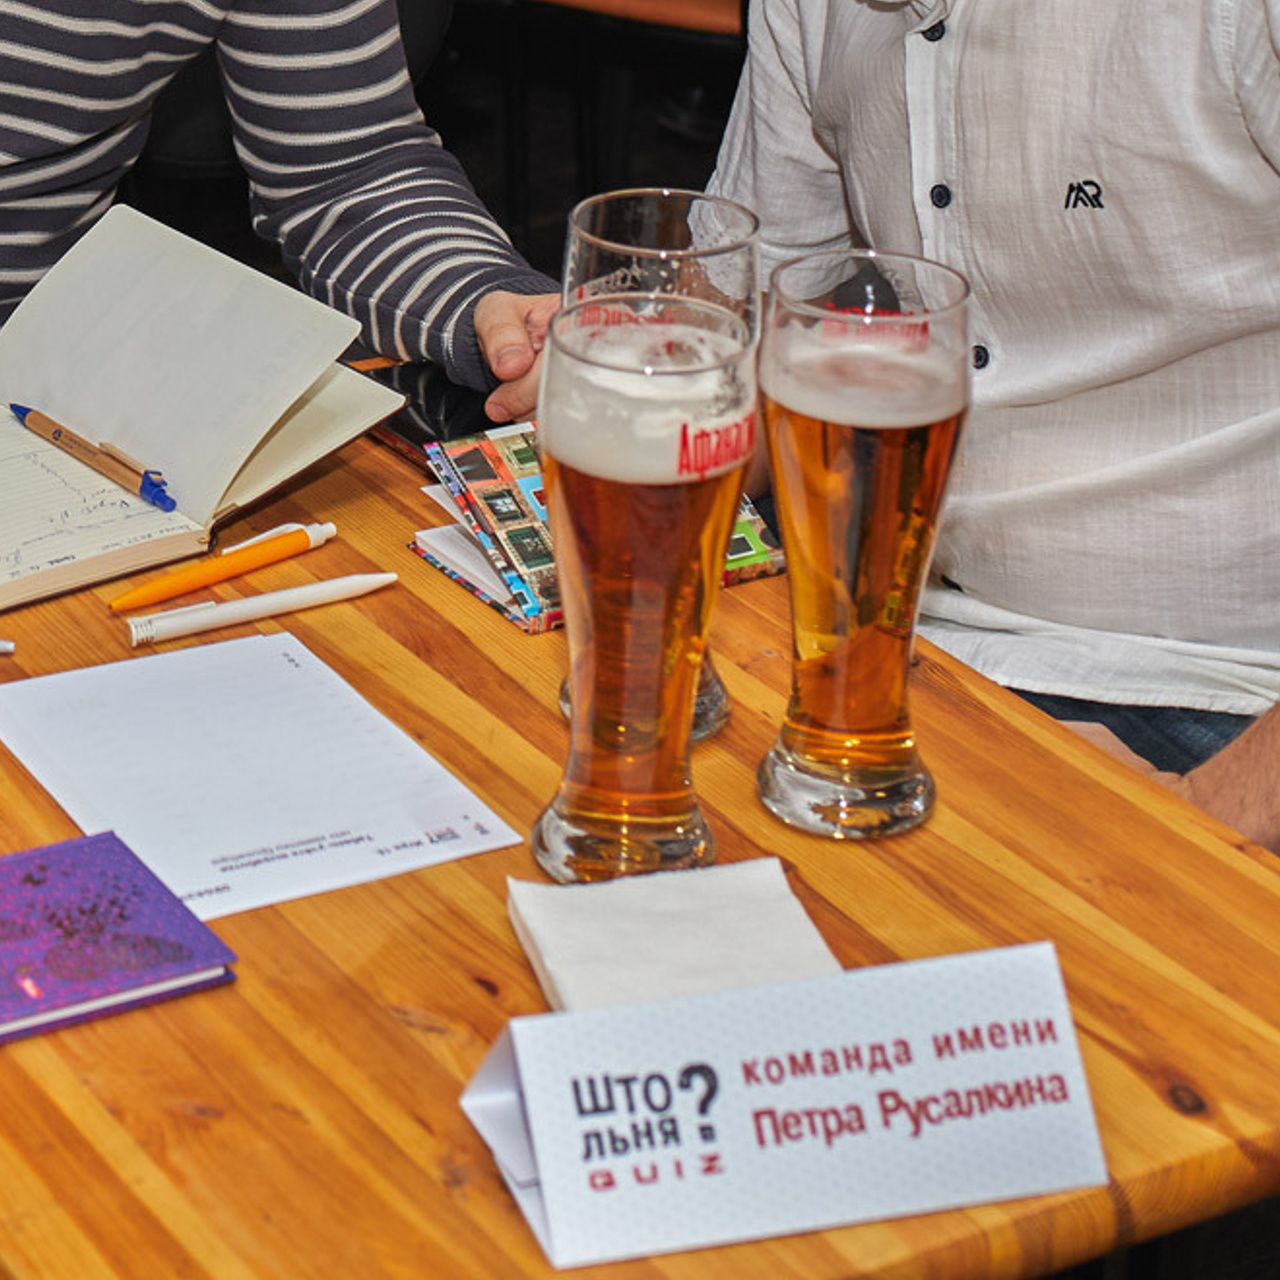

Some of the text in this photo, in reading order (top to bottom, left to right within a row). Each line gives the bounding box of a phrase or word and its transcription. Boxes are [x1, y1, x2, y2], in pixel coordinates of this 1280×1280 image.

[741, 1018, 1058, 1086] команда имени
[752, 1072, 1069, 1149] Петра Русалкина
[588, 1152, 725, 1193] QUIZ
